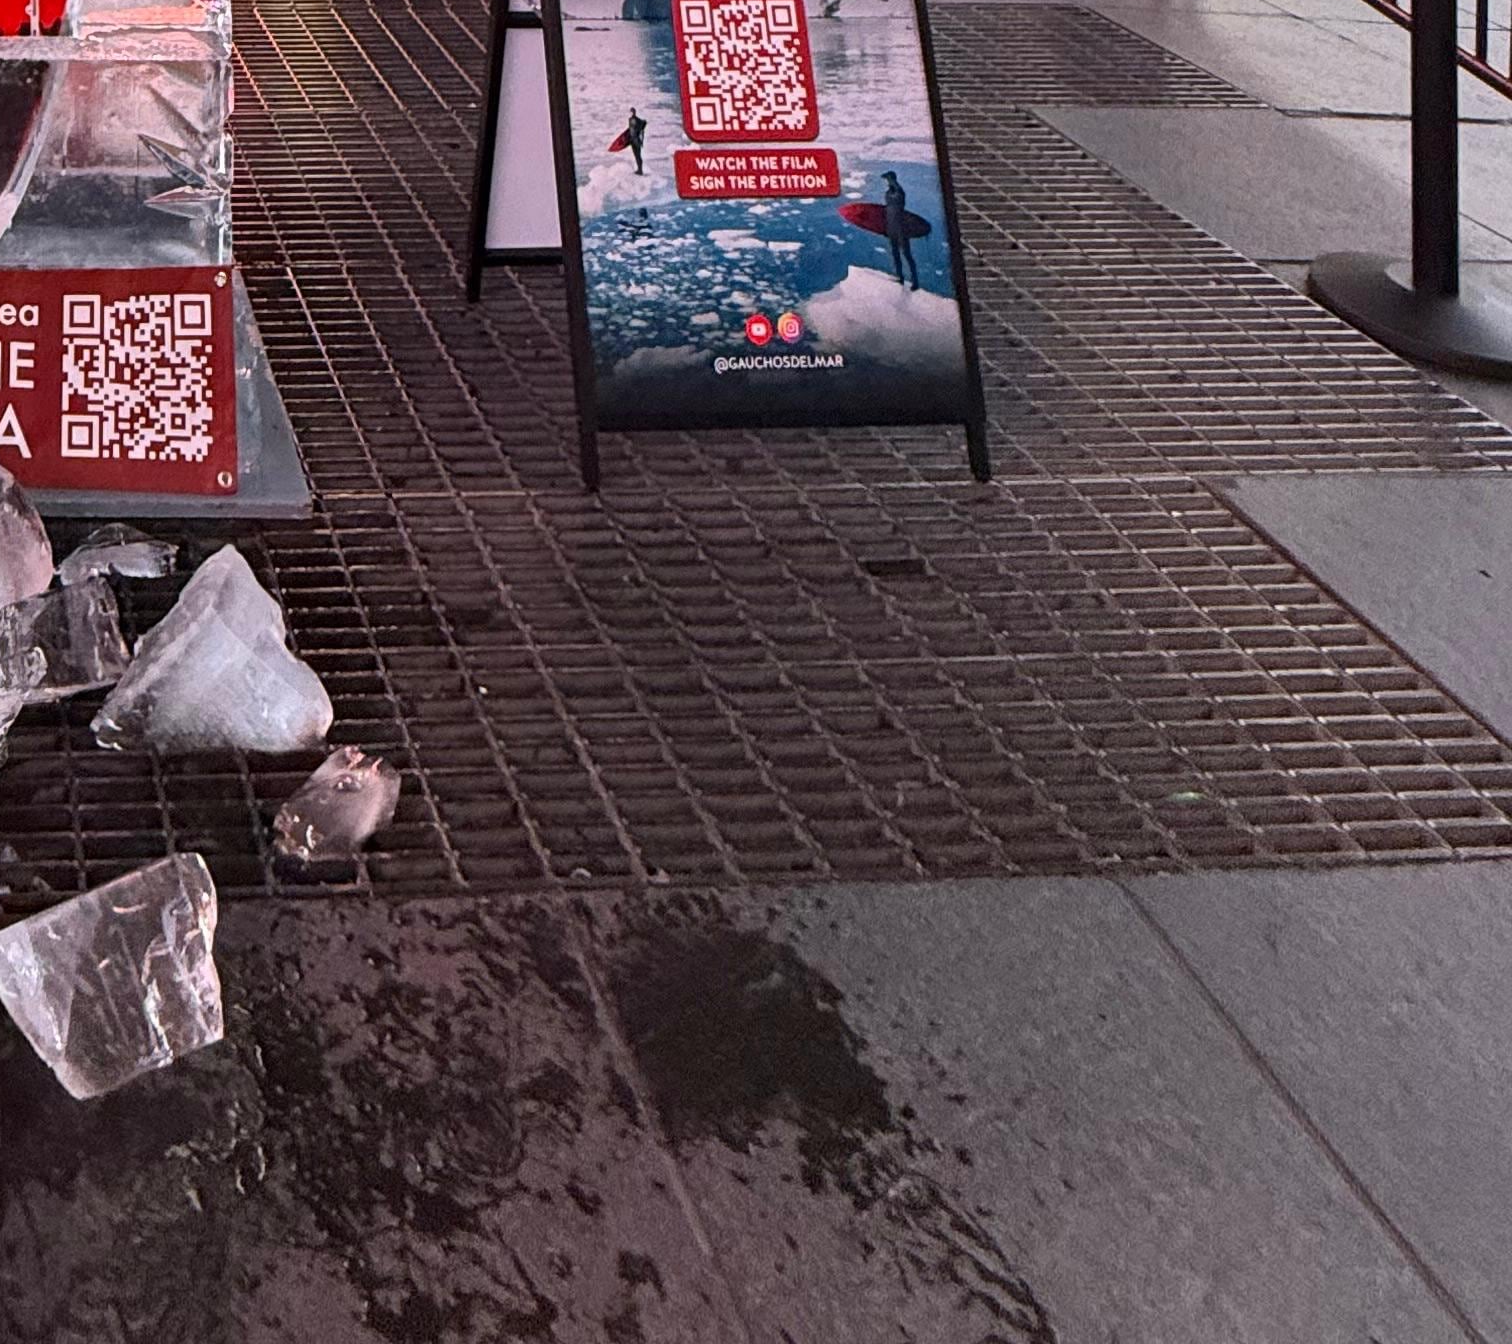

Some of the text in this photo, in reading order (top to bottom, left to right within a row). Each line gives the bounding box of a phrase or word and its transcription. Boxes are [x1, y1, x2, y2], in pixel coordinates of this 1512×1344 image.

[696, 156, 817, 171] WATCH THE FILM
[690, 174, 827, 190] SIGN THE PETITION
[714, 355, 844, 374] @GAUCHOSDELMAR
